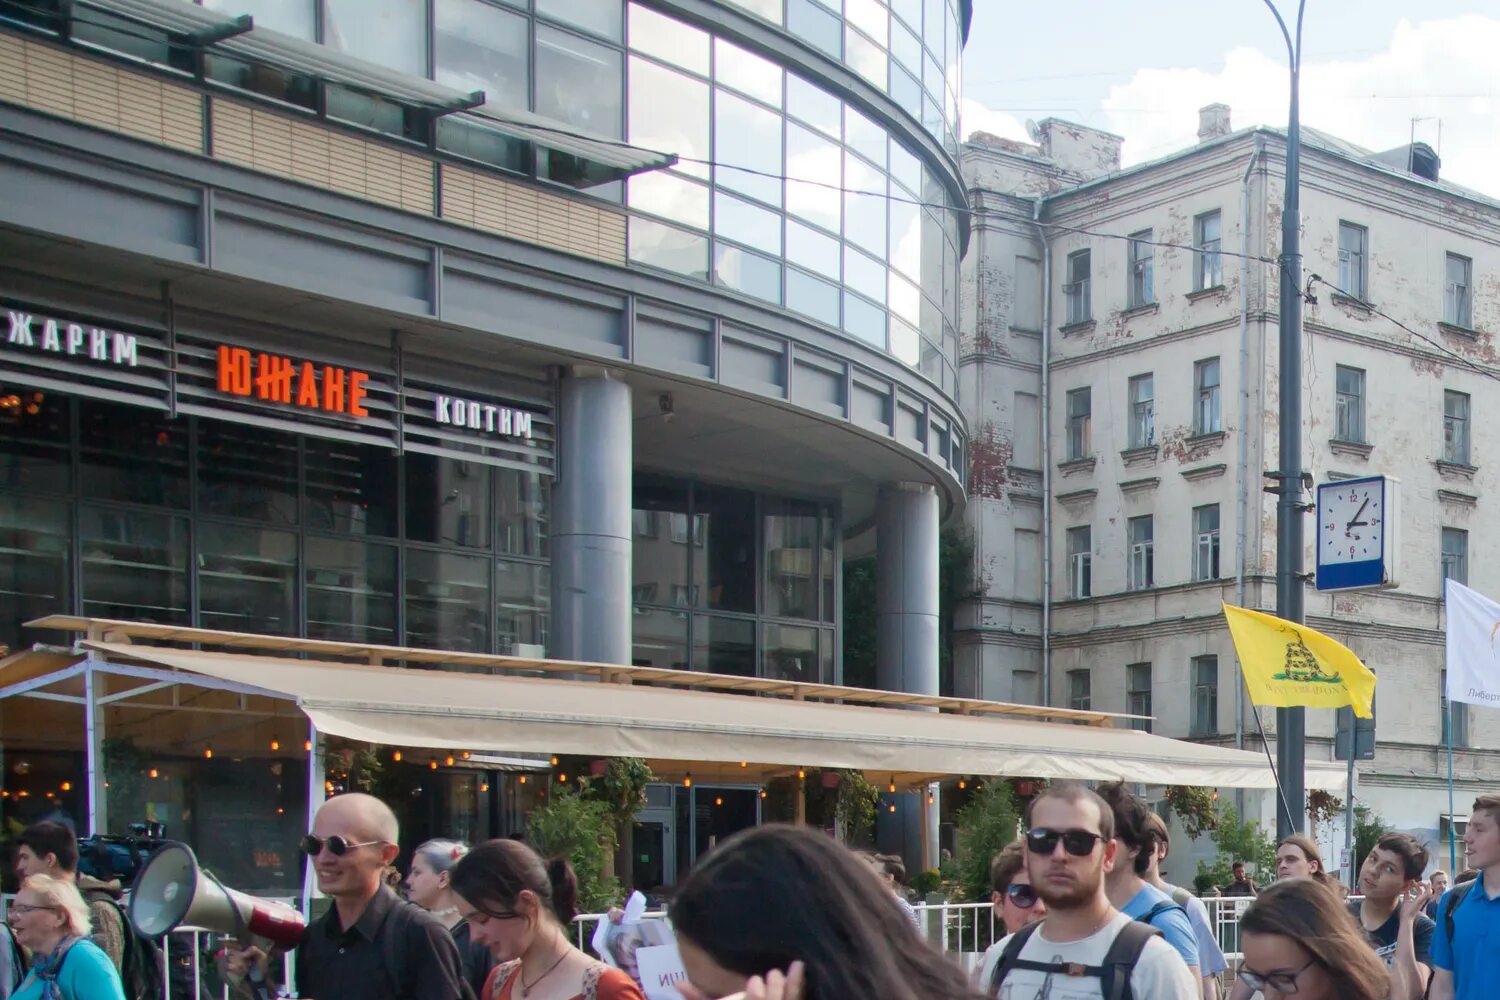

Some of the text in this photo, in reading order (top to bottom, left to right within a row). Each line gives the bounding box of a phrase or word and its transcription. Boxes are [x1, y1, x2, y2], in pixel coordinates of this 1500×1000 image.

[216, 345, 369, 417] ЮЖАНЕ
[434, 396, 533, 439] КОПТИМ
[1349, 495, 1358, 503] 12
